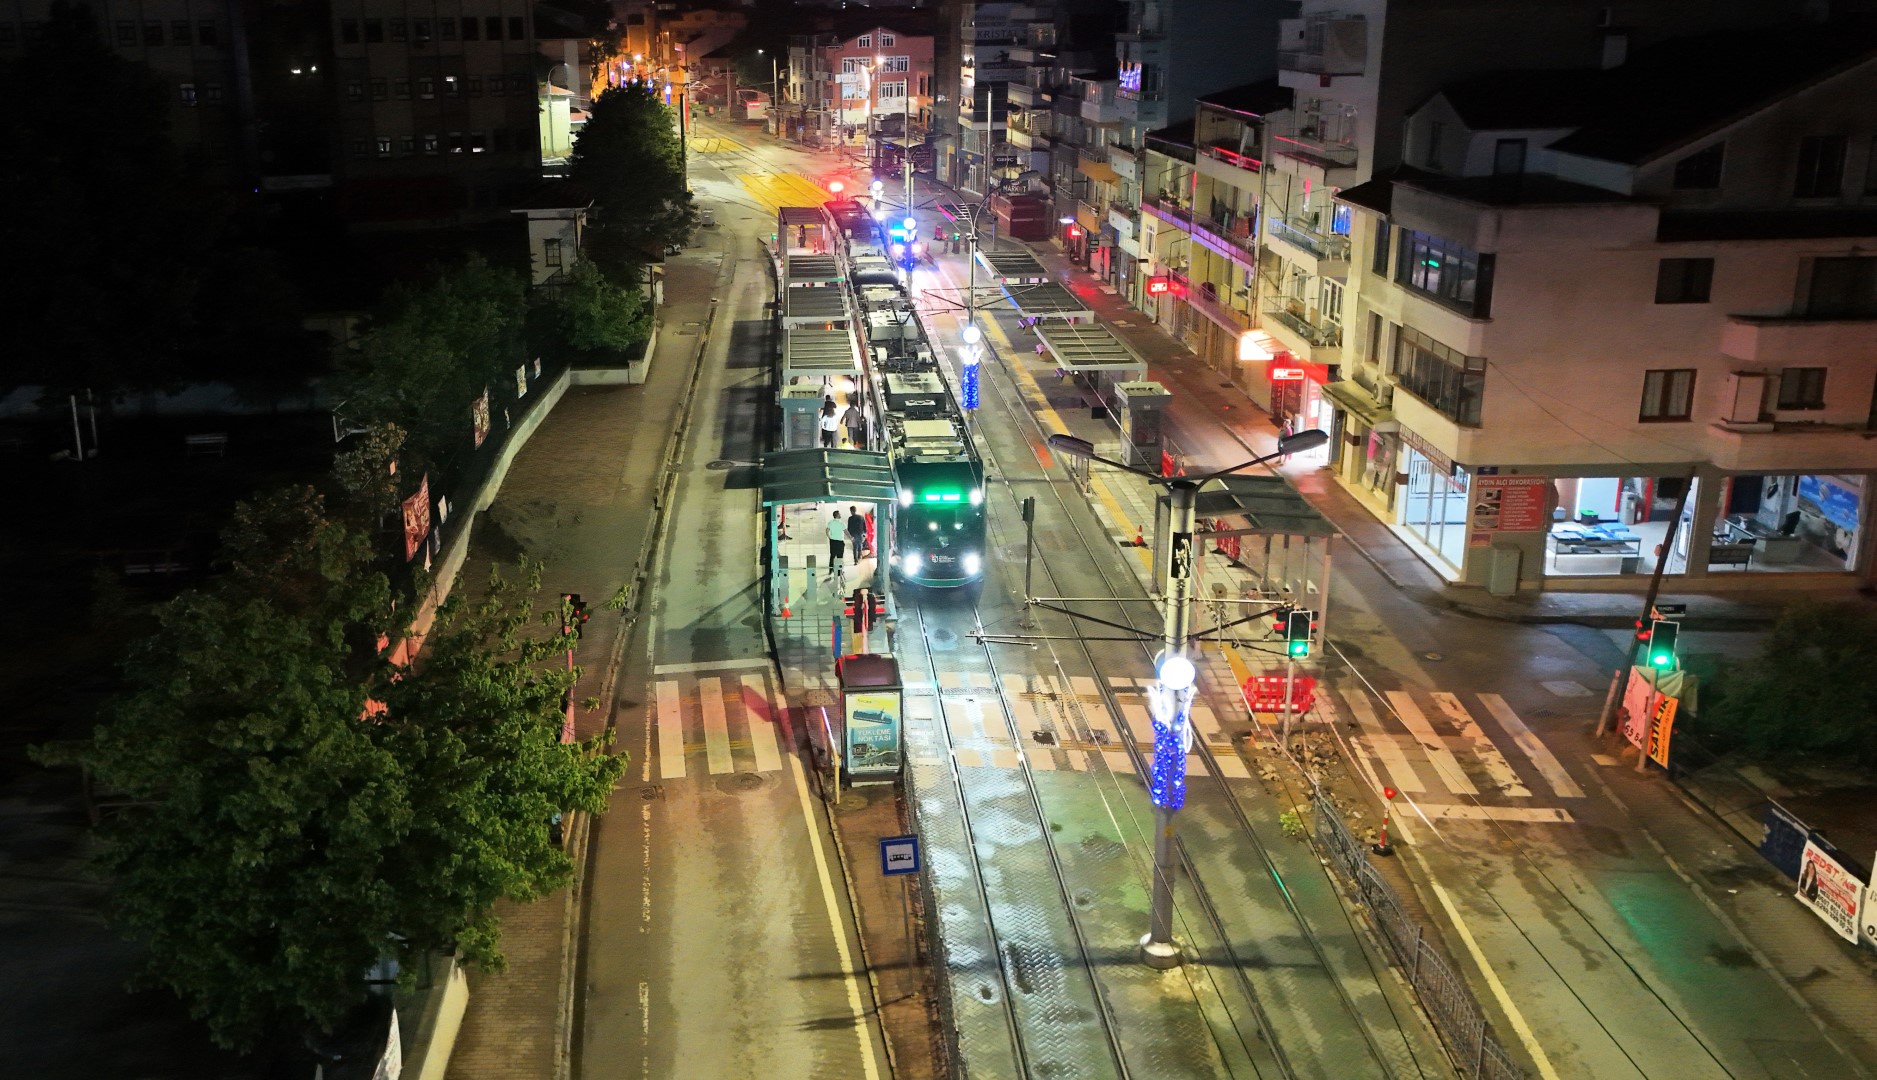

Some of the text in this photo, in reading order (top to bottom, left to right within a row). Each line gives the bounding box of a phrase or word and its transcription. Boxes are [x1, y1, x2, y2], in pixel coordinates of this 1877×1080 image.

[1478, 479, 1495, 487] AYDIN
[1509, 478, 1545, 486] DEKORASYON
[1651, 700, 1669, 758] SATILIK
